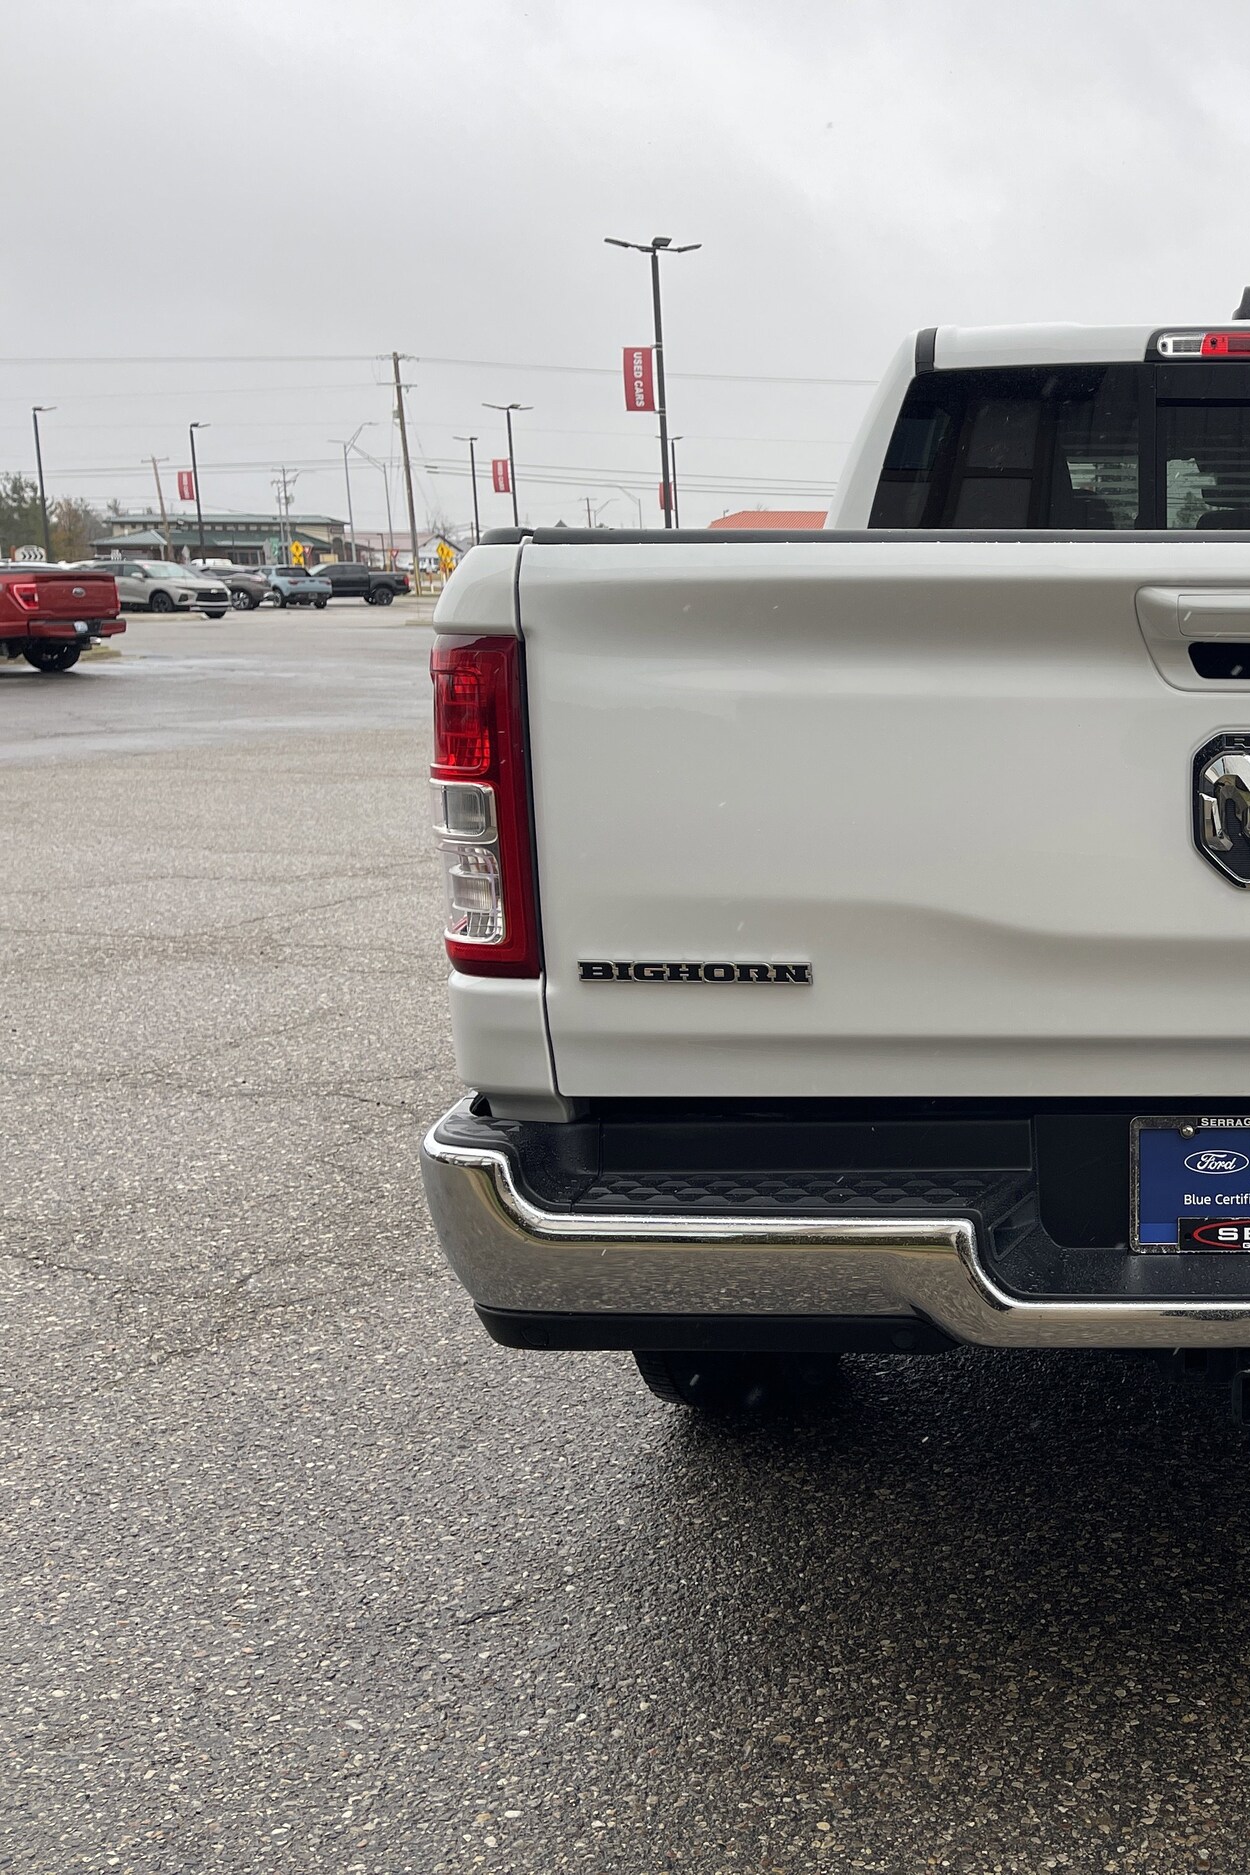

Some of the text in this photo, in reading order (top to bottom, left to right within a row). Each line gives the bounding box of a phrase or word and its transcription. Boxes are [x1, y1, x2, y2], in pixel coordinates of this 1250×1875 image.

[633, 351, 645, 408] USED CARS
[577, 959, 813, 984] BIGHORN
[1196, 1152, 1237, 1171] Ford
[1183, 1194, 1212, 1205] Blue
